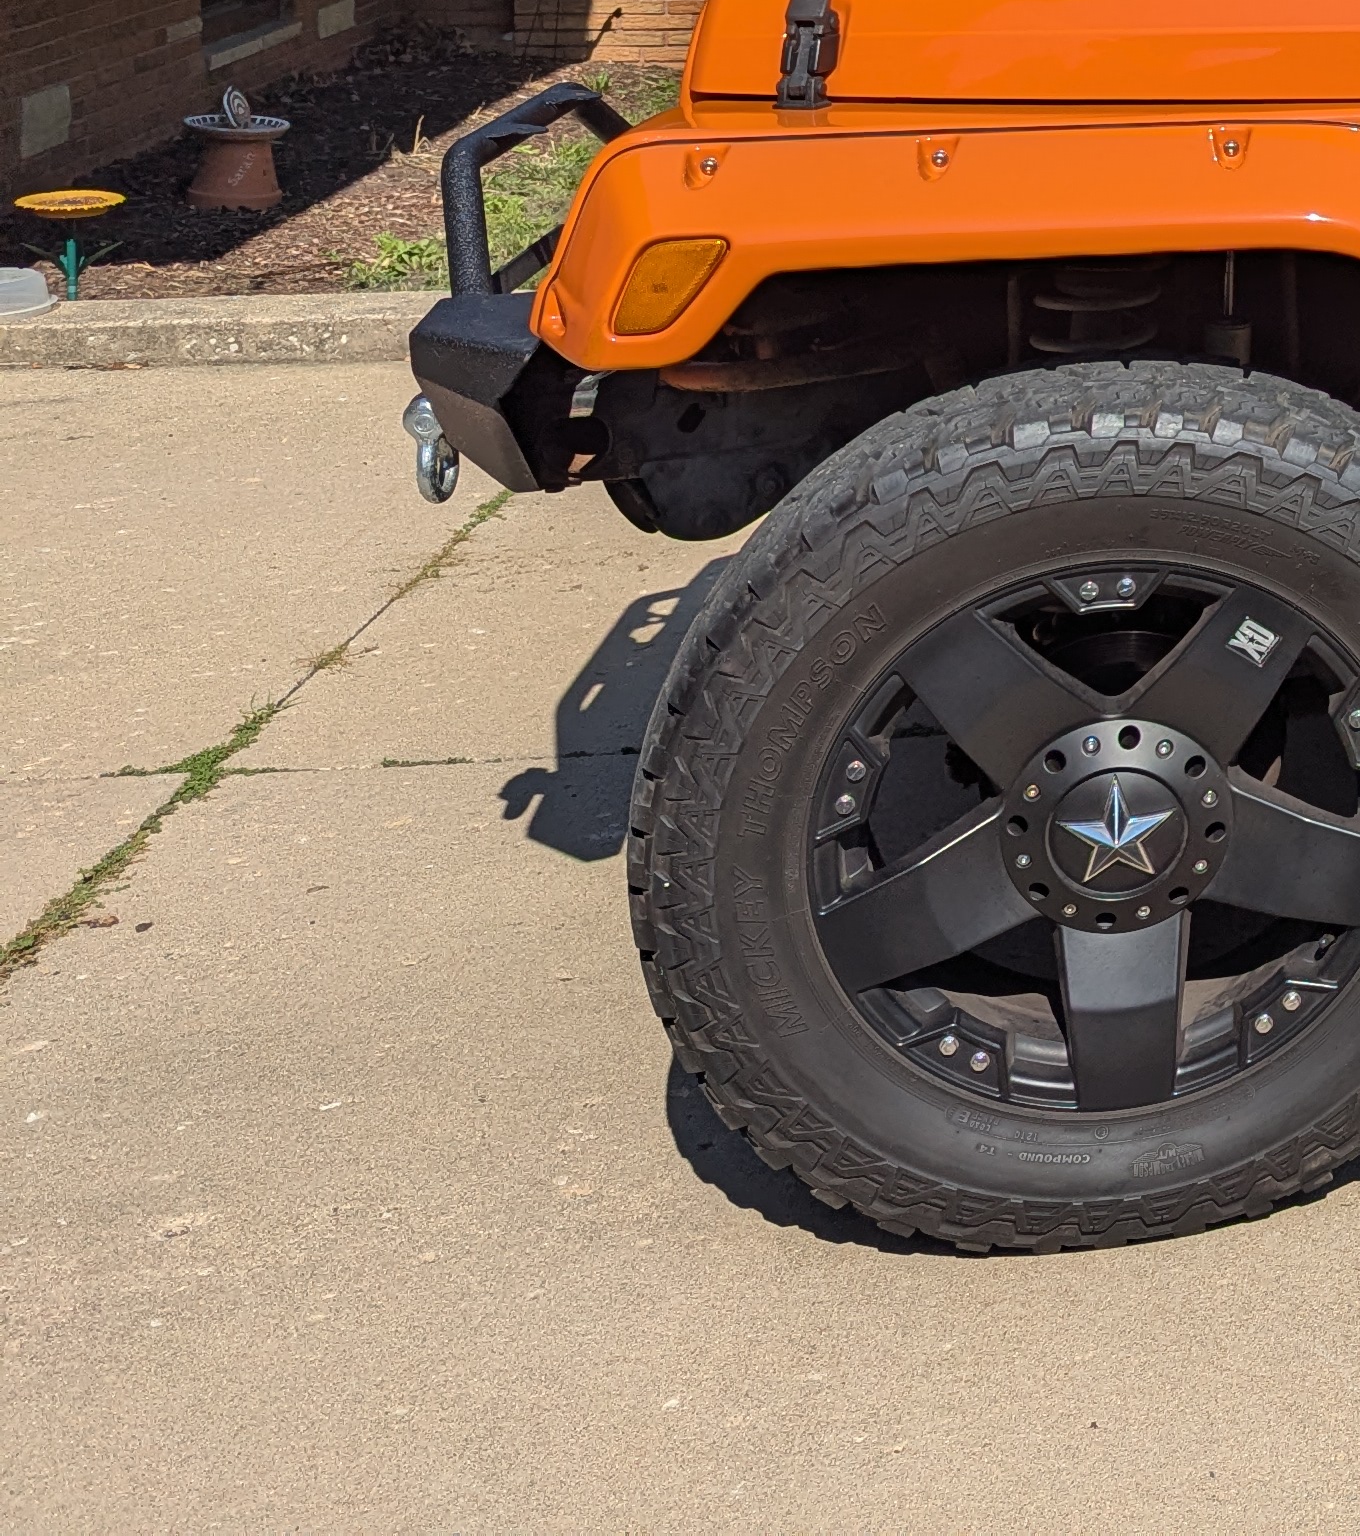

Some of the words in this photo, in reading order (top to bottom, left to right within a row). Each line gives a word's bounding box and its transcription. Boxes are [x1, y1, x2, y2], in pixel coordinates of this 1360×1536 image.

[738, 602, 889, 840] THOMPSON
[731, 862, 810, 1039] MICKEY
[1018, 1151, 1091, 1164] COMPOUND
